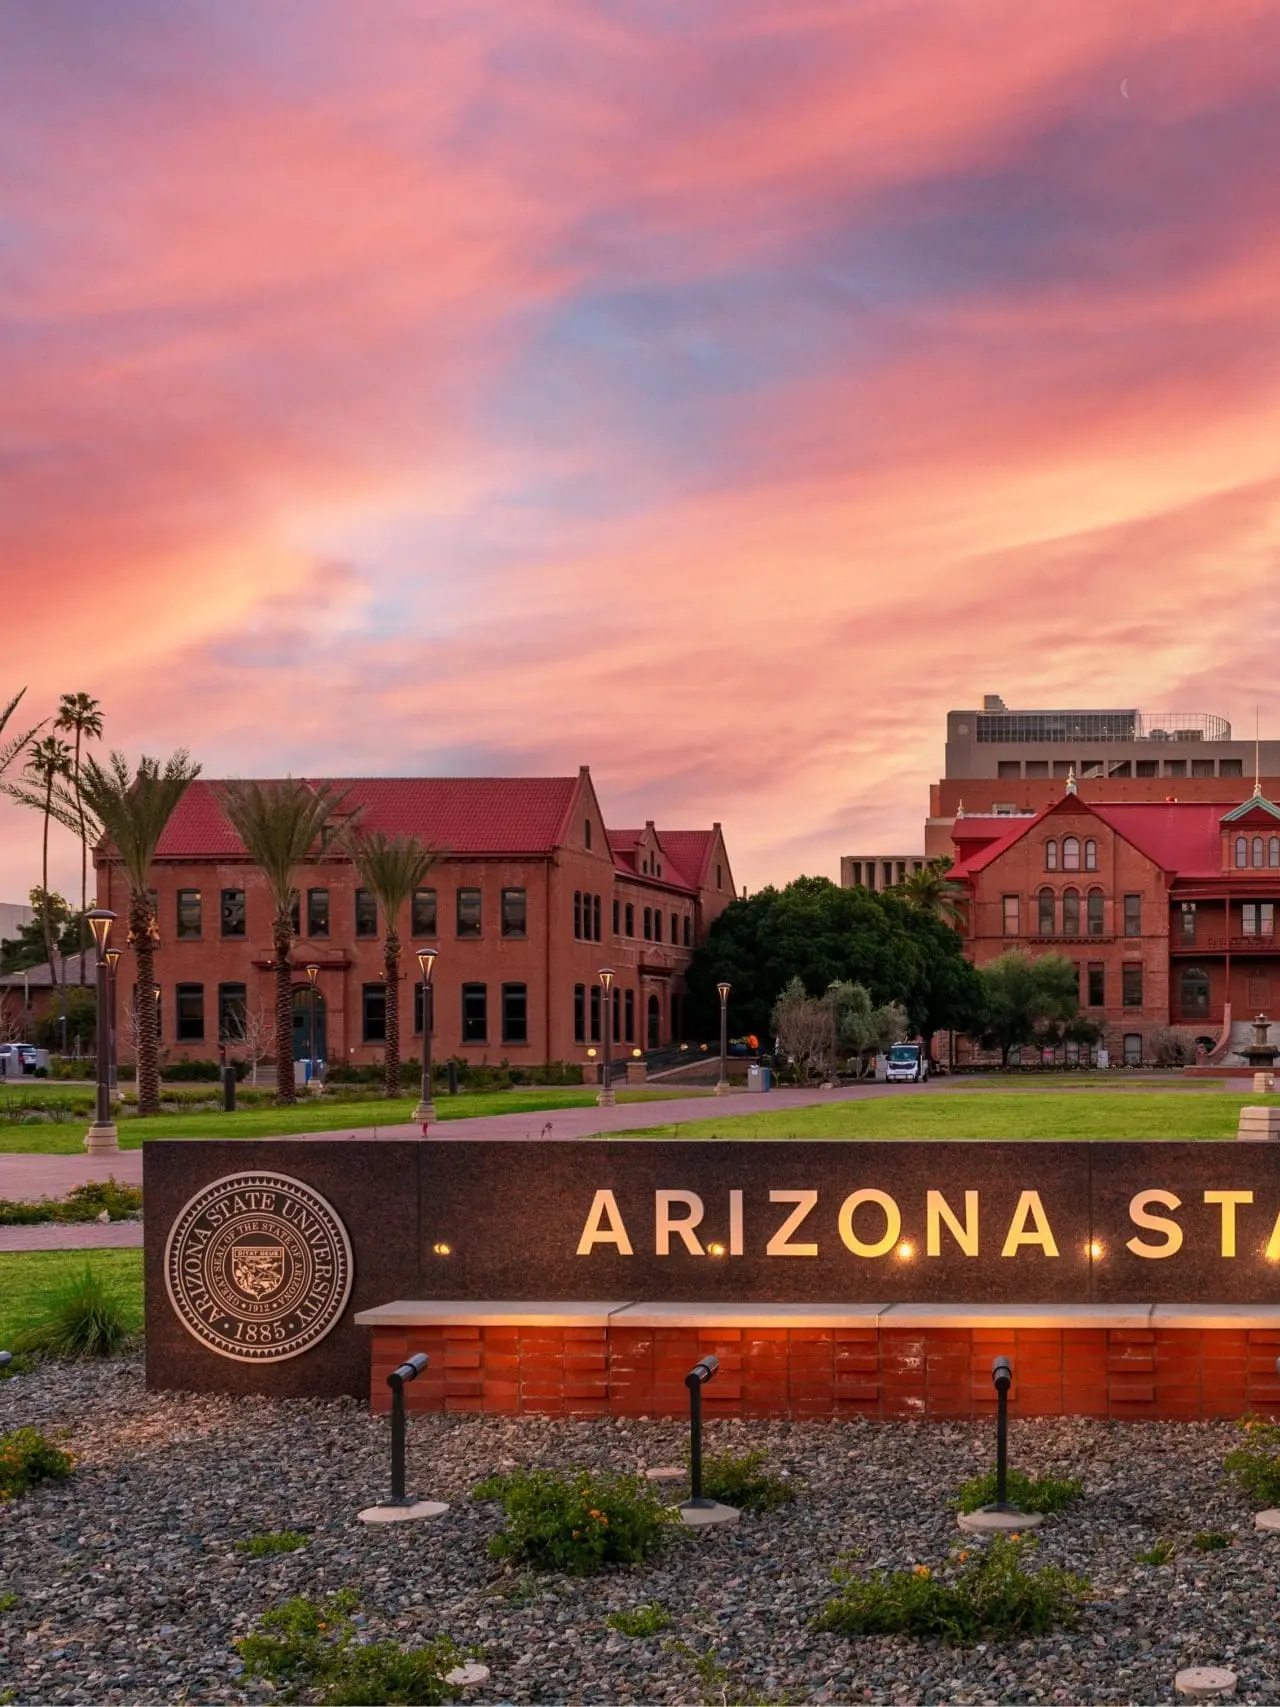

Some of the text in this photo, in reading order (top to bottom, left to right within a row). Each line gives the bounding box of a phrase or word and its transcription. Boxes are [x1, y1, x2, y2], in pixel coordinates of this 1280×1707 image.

[576, 1188, 1060, 1258] ARIZONA
[184, 1192, 332, 1328] ARIZONA STATE UNIVERSITY
[214, 1222, 303, 1306] GREAT SEAL OF THE STATE OF ARIZONA
[233, 1321, 286, 1342] 1885
[247, 1303, 271, 1312] 1912
